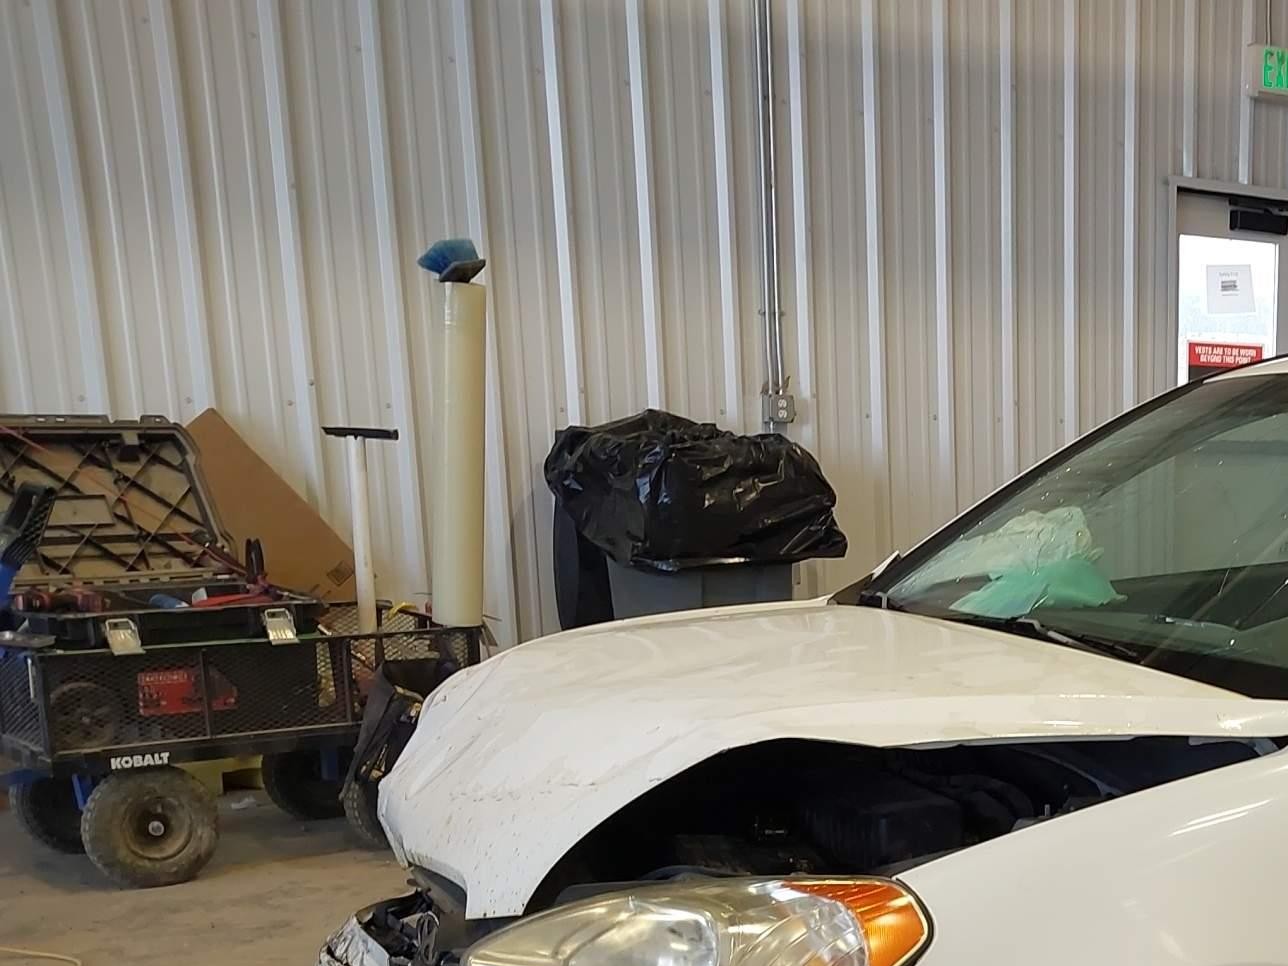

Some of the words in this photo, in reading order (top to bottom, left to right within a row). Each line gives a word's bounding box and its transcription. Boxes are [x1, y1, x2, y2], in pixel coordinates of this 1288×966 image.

[1224, 348, 1232, 356] TO
[1232, 348, 1240, 356] BE
[1223, 355, 1235, 364] THIS
[110, 752, 170, 770] KOBALT
